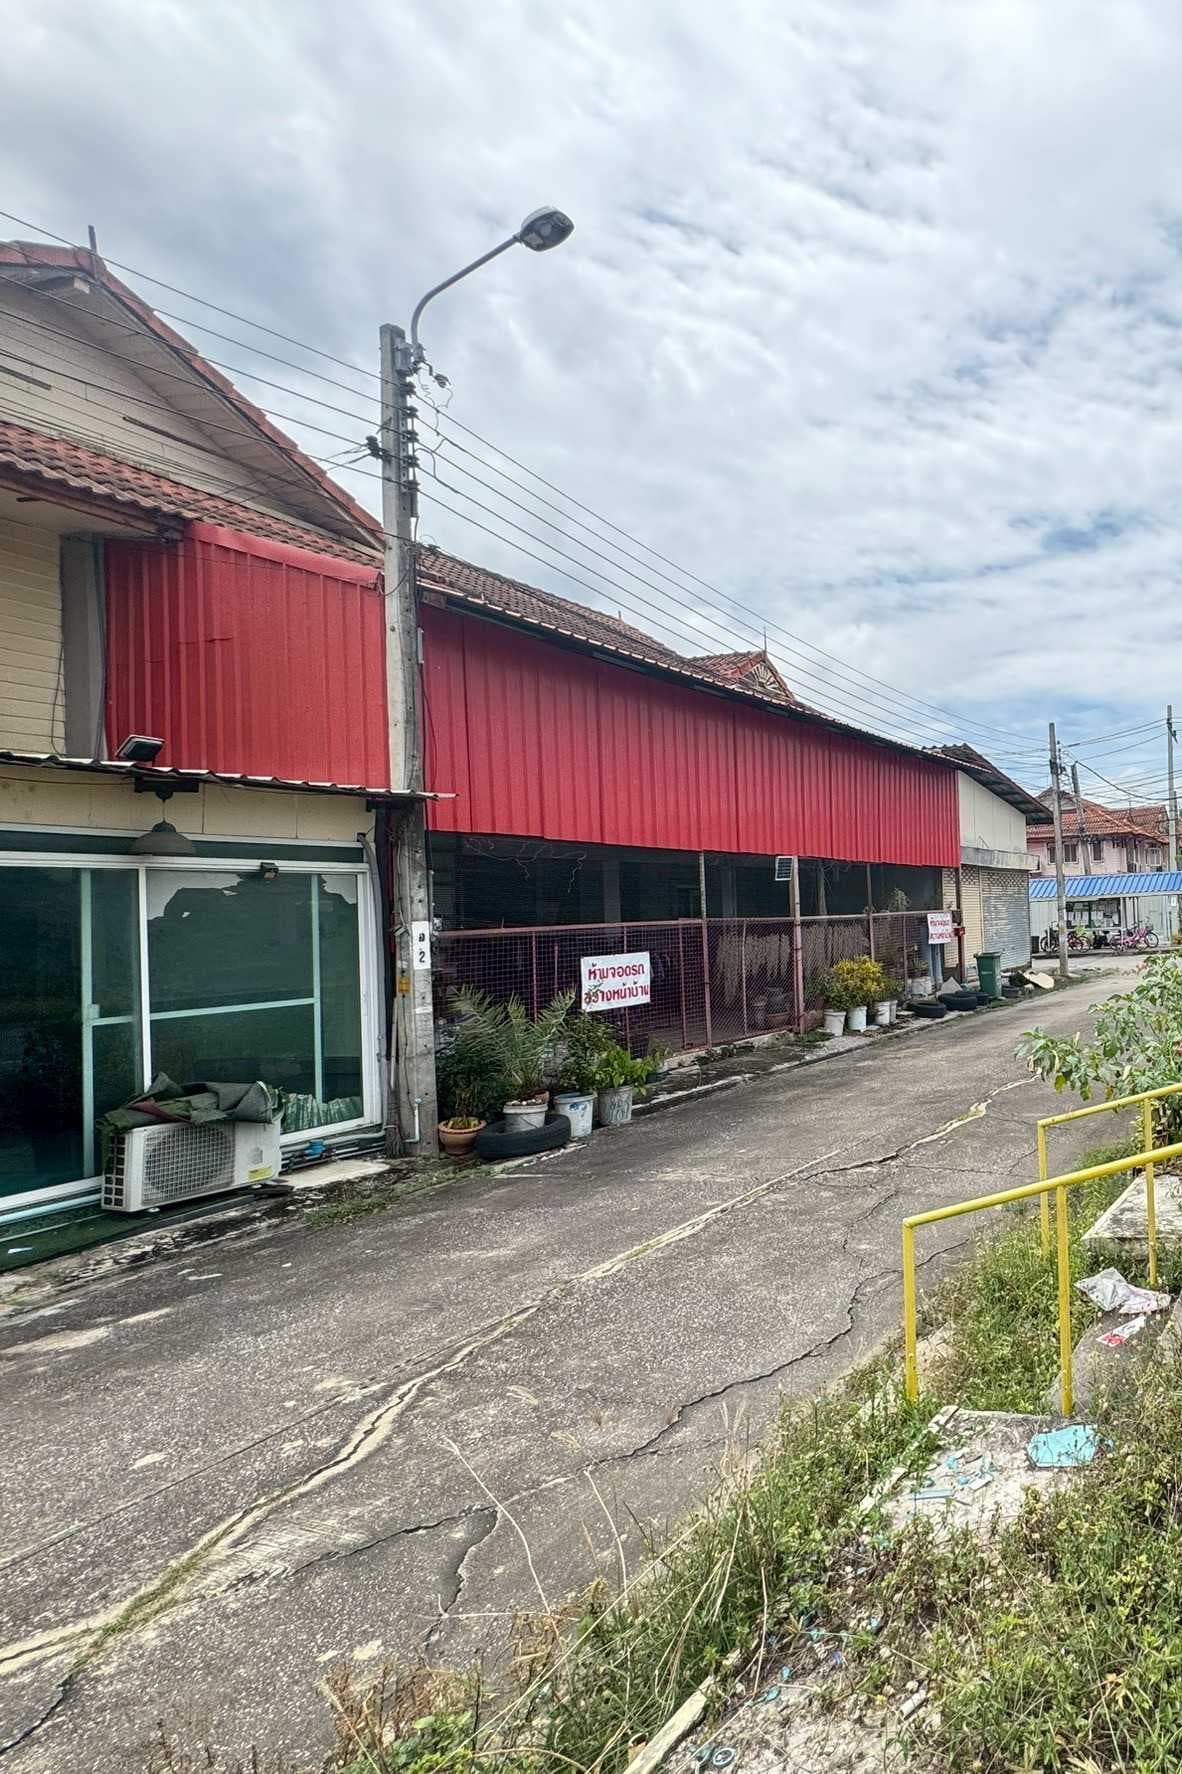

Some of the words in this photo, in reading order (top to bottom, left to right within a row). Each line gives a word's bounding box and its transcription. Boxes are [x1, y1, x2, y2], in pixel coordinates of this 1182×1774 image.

[419, 951, 426, 963] 2
[588, 962, 645, 980] ห้ามจอดรถ
